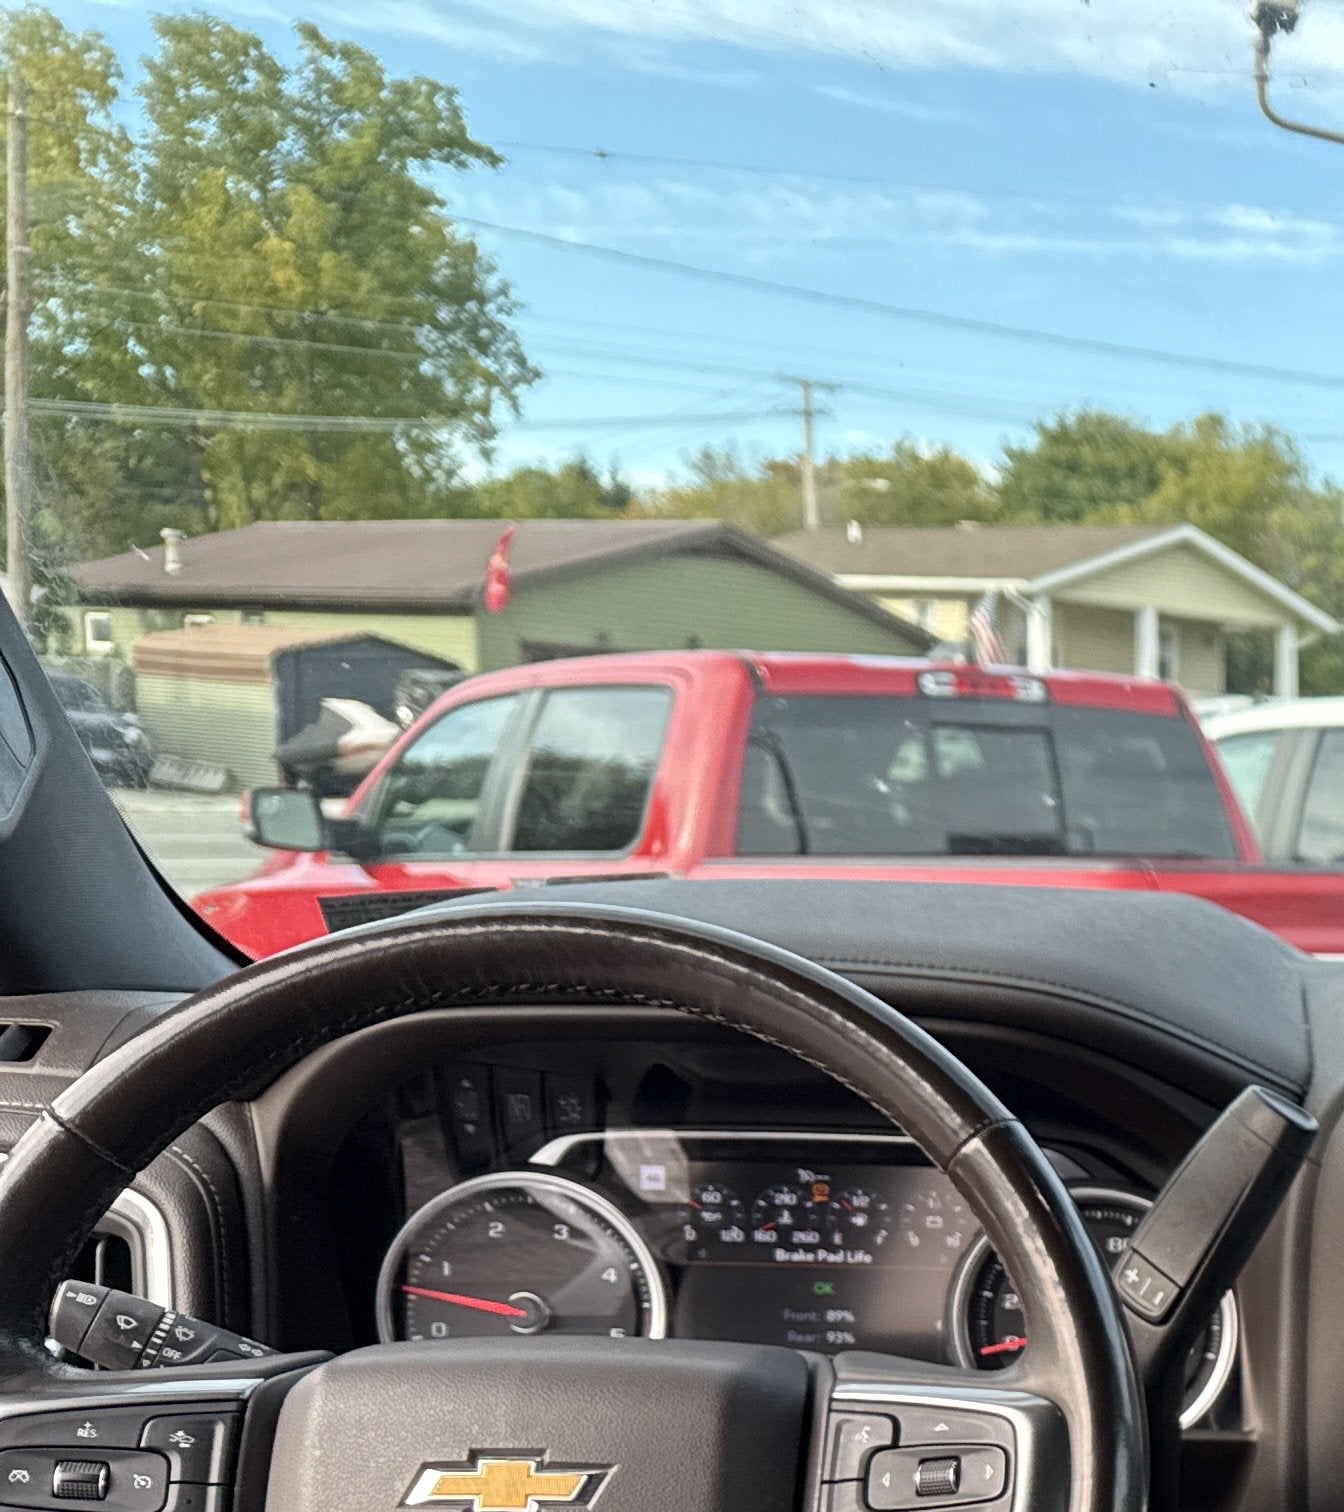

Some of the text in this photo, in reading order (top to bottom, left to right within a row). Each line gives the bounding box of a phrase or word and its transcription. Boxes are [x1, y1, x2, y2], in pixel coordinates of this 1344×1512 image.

[488, 1221, 505, 1238] 2
[553, 1223, 569, 1240] 3
[775, 1247, 874, 1264] Brake Pad Life
[441, 1261, 450, 1277] 1
[602, 1267, 617, 1283] 4
[813, 1281, 834, 1296] OK
[825, 1308, 856, 1323] 89%
[430, 1321, 448, 1338] 0
[825, 1330, 856, 1344] 93%
[162, 1347, 182, 1360] OFF
[77, 1428, 98, 1438] RES
